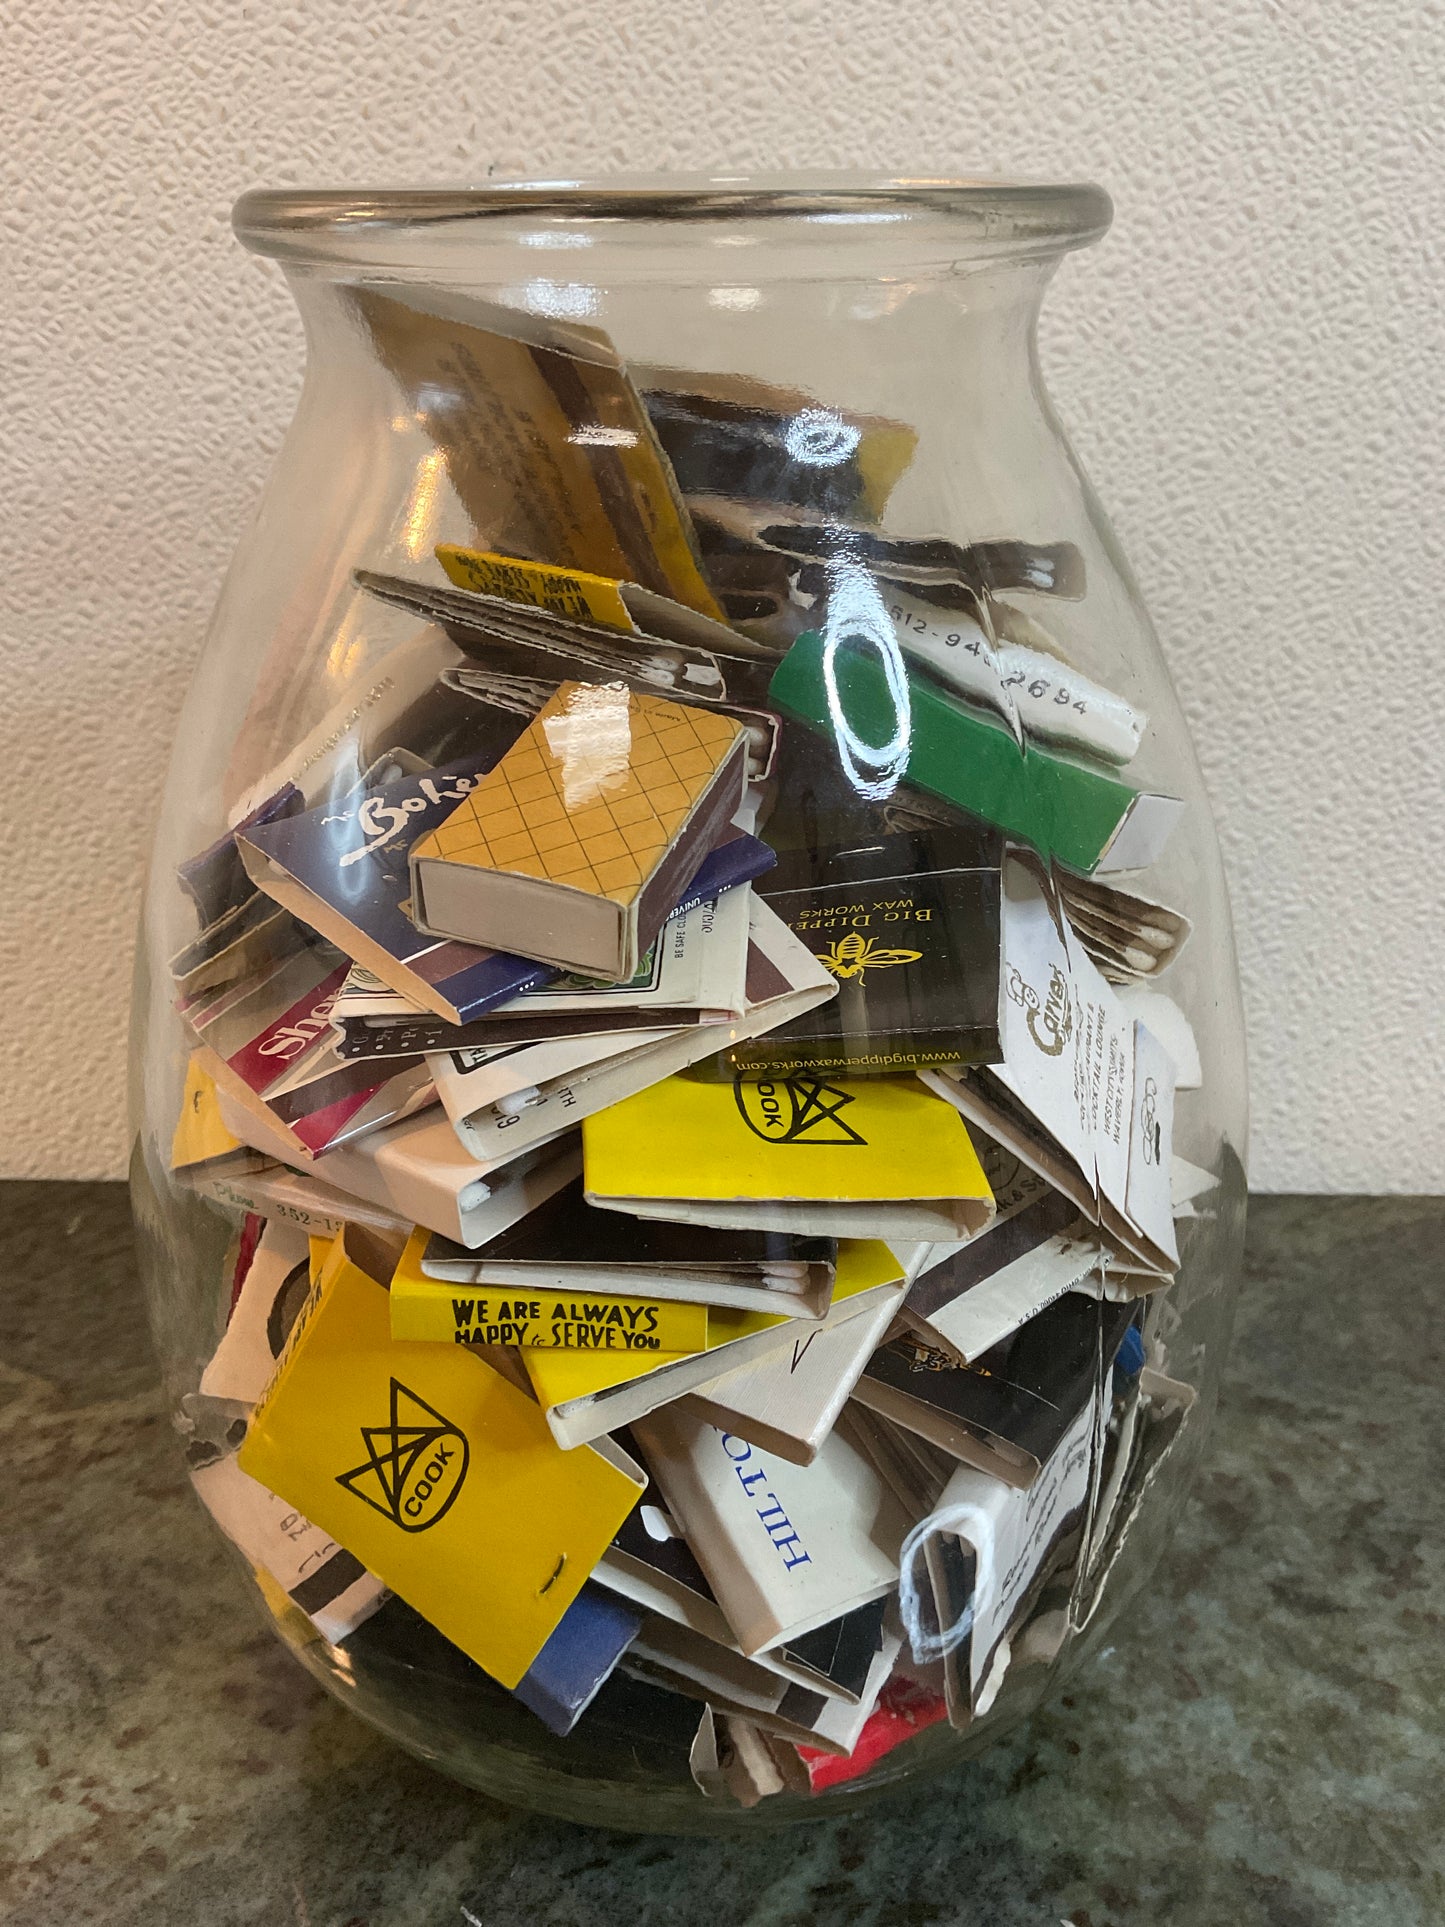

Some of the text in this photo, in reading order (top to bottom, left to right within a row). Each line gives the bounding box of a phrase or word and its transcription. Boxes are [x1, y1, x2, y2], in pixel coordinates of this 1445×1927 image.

[799, 899, 914, 919] WAX WORKS
[884, 908, 934, 922] BIG
[258, 987, 341, 1060] She
[736, 1051, 961, 1070] www.bigdipperwaxworks.com
[757, 1081, 785, 1128] OOK
[452, 1299, 660, 1332] WE ARE ALWAYS
[454, 1322, 529, 1345] HAPPY
[551, 1322, 617, 1348] SERVE
[404, 1442, 455, 1518] COOK
[713, 1427, 812, 1573] HILTO
